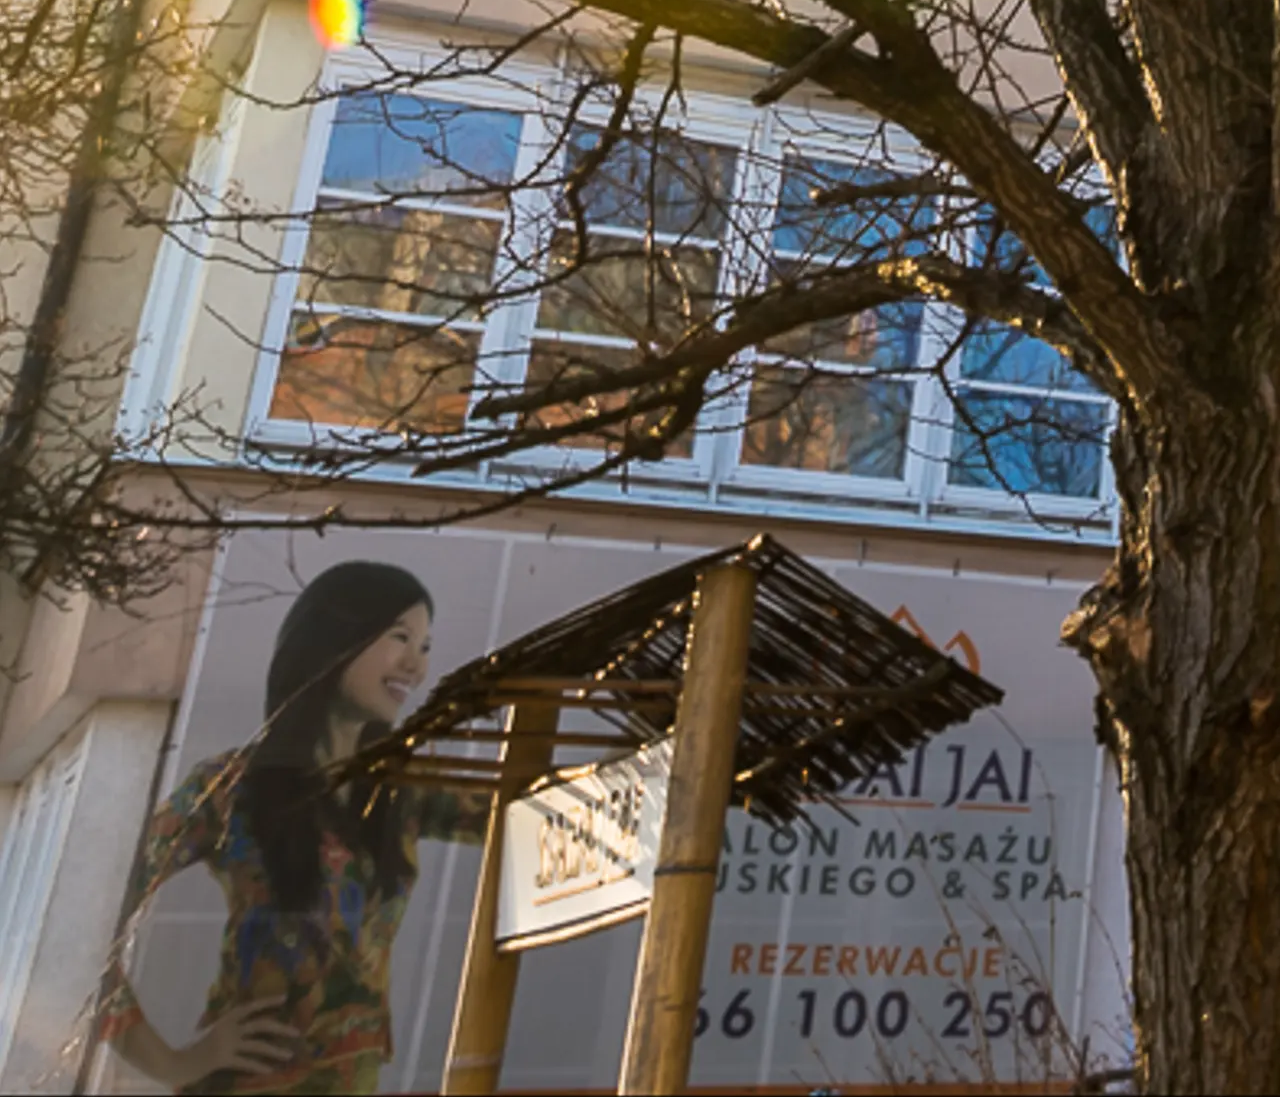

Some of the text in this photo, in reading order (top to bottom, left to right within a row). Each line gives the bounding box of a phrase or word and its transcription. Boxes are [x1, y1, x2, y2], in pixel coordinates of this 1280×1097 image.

[941, 744, 1033, 808] JAI
[863, 825, 1053, 865] MASAŻU
[941, 870, 967, 900] &
[991, 871, 1067, 901] SPA
[730, 943, 1000, 979] REZERWACJE
[797, 989, 910, 1040] 100
[941, 989, 1053, 1040] 250
